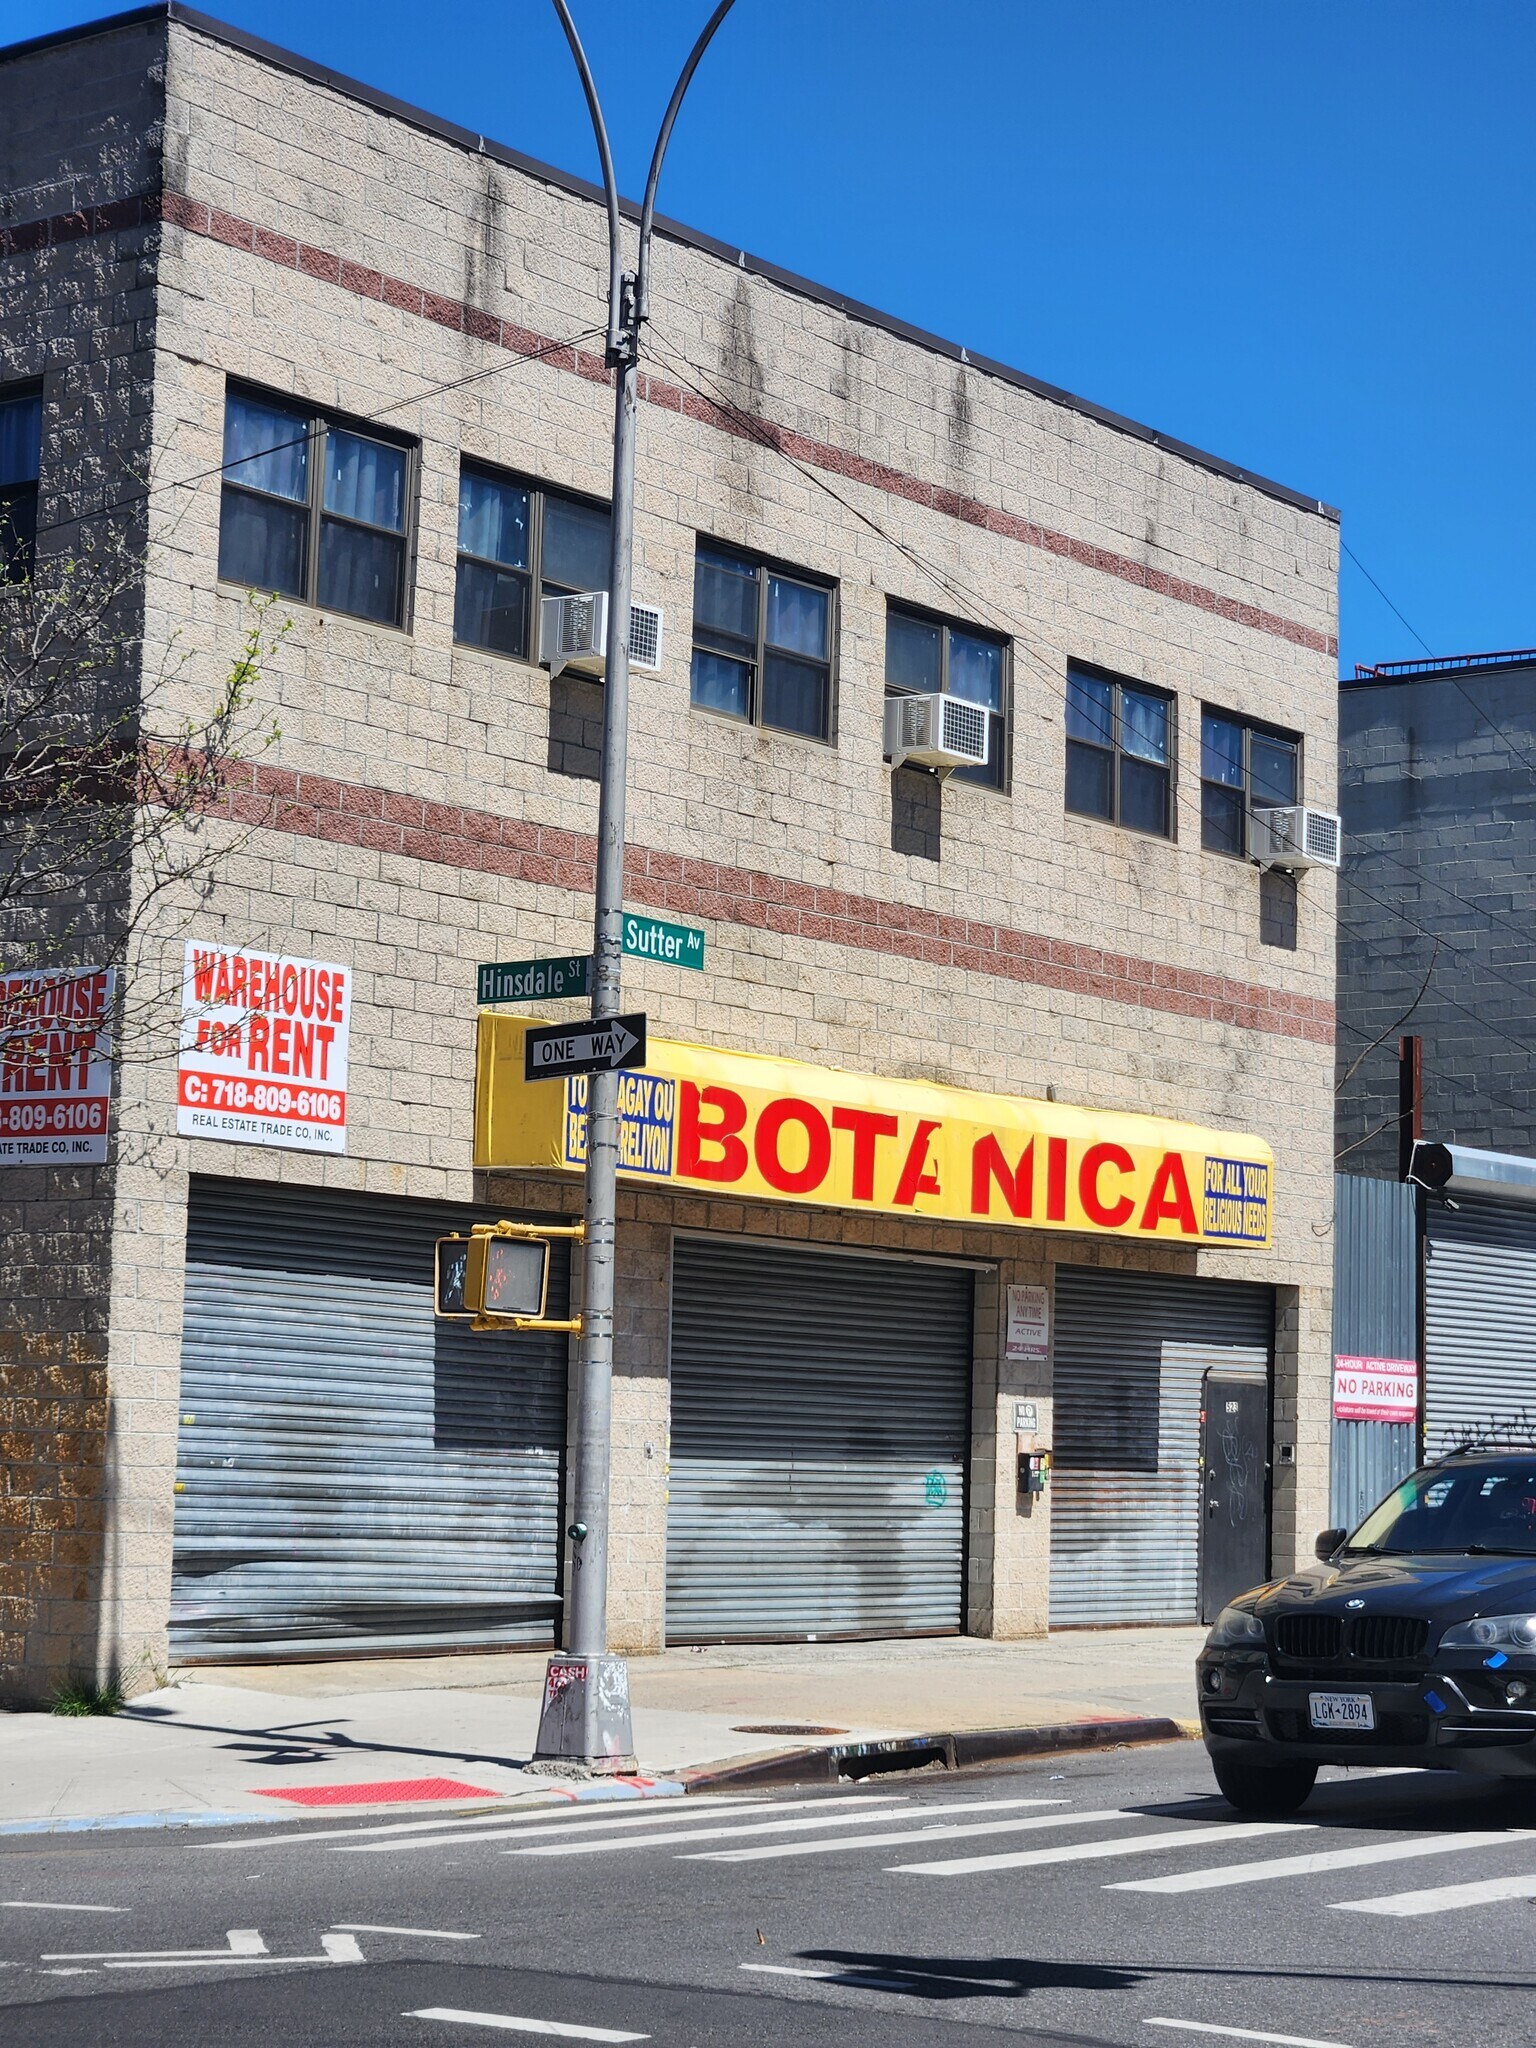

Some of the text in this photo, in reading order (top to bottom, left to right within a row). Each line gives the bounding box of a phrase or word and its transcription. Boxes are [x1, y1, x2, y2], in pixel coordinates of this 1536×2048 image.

[626, 919, 701, 960] Sutter Av
[193, 948, 345, 1024] WAREHOUSE
[482, 959, 581, 999] Hinsdale St
[0, 973, 108, 1031] EHOUSE
[2, 1032, 96, 1093] RENT
[197, 1016, 336, 1081] FOR RENT
[542, 1033, 627, 1063] ONE WAY
[0, 1102, 102, 1132] -809-6106
[184, 1075, 341, 1121] C: 718-809-6106
[617, 1076, 653, 1118] AGAY
[16, 1141, 49, 1154] TRADE
[72, 1140, 93, 1153] INC.
[192, 1113, 219, 1128] REAL
[221, 1117, 258, 1133] ESTATE
[261, 1122, 292, 1137] TRADE
[314, 1129, 333, 1142] INC.
[619, 1120, 670, 1171] RELIYON
[1205, 1160, 1267, 1199] FOR ALL YOUR
[1204, 1197, 1266, 1238] RELIGIOUS NEEDS
[1015, 1327, 1042, 1337] ACTIVE
[1337, 1377, 1414, 1398] NO PARKING
